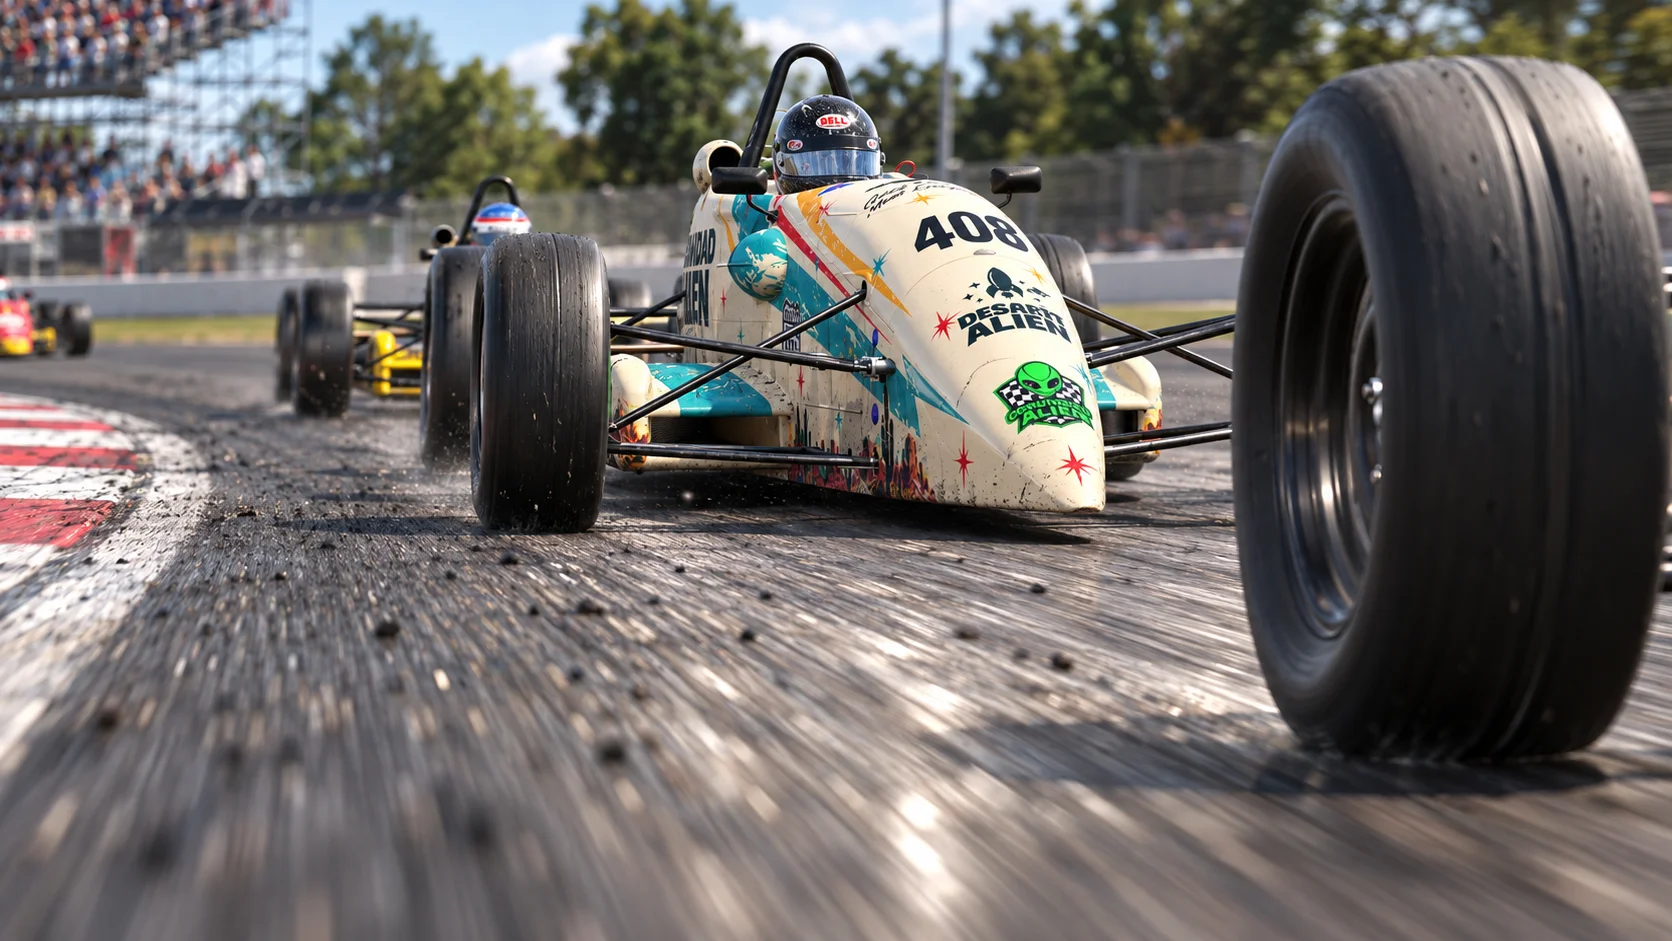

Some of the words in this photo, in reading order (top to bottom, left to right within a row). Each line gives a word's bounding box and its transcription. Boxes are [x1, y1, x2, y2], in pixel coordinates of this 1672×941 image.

[914, 211, 1029, 252] 408
[967, 313, 1072, 347] ALIEN
[1022, 406, 1092, 426] ALIEN
